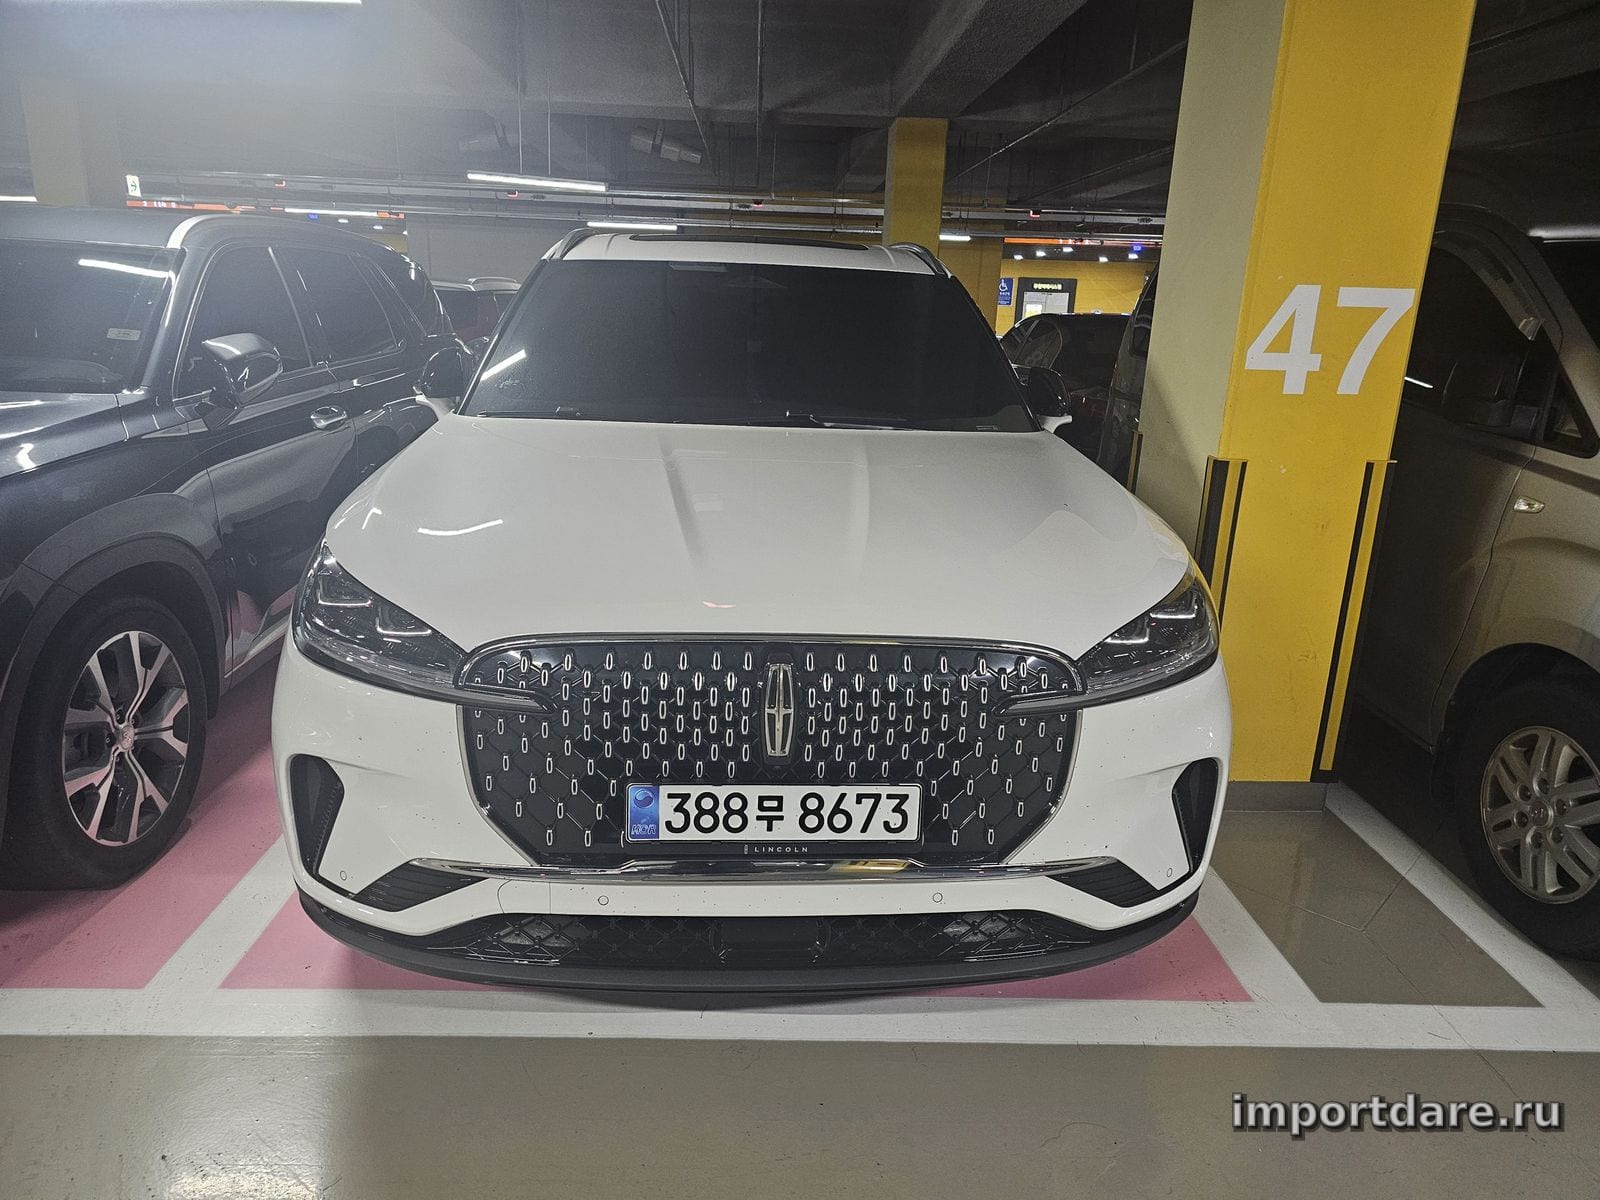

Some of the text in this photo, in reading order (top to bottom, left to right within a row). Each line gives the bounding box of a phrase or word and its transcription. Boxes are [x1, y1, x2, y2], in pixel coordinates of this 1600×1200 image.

[1244, 284, 1416, 395] 47
[664, 791, 911, 834] 388무 8673
[630, 823, 657, 835] KOR
[754, 846, 808, 854] LINCOLN
